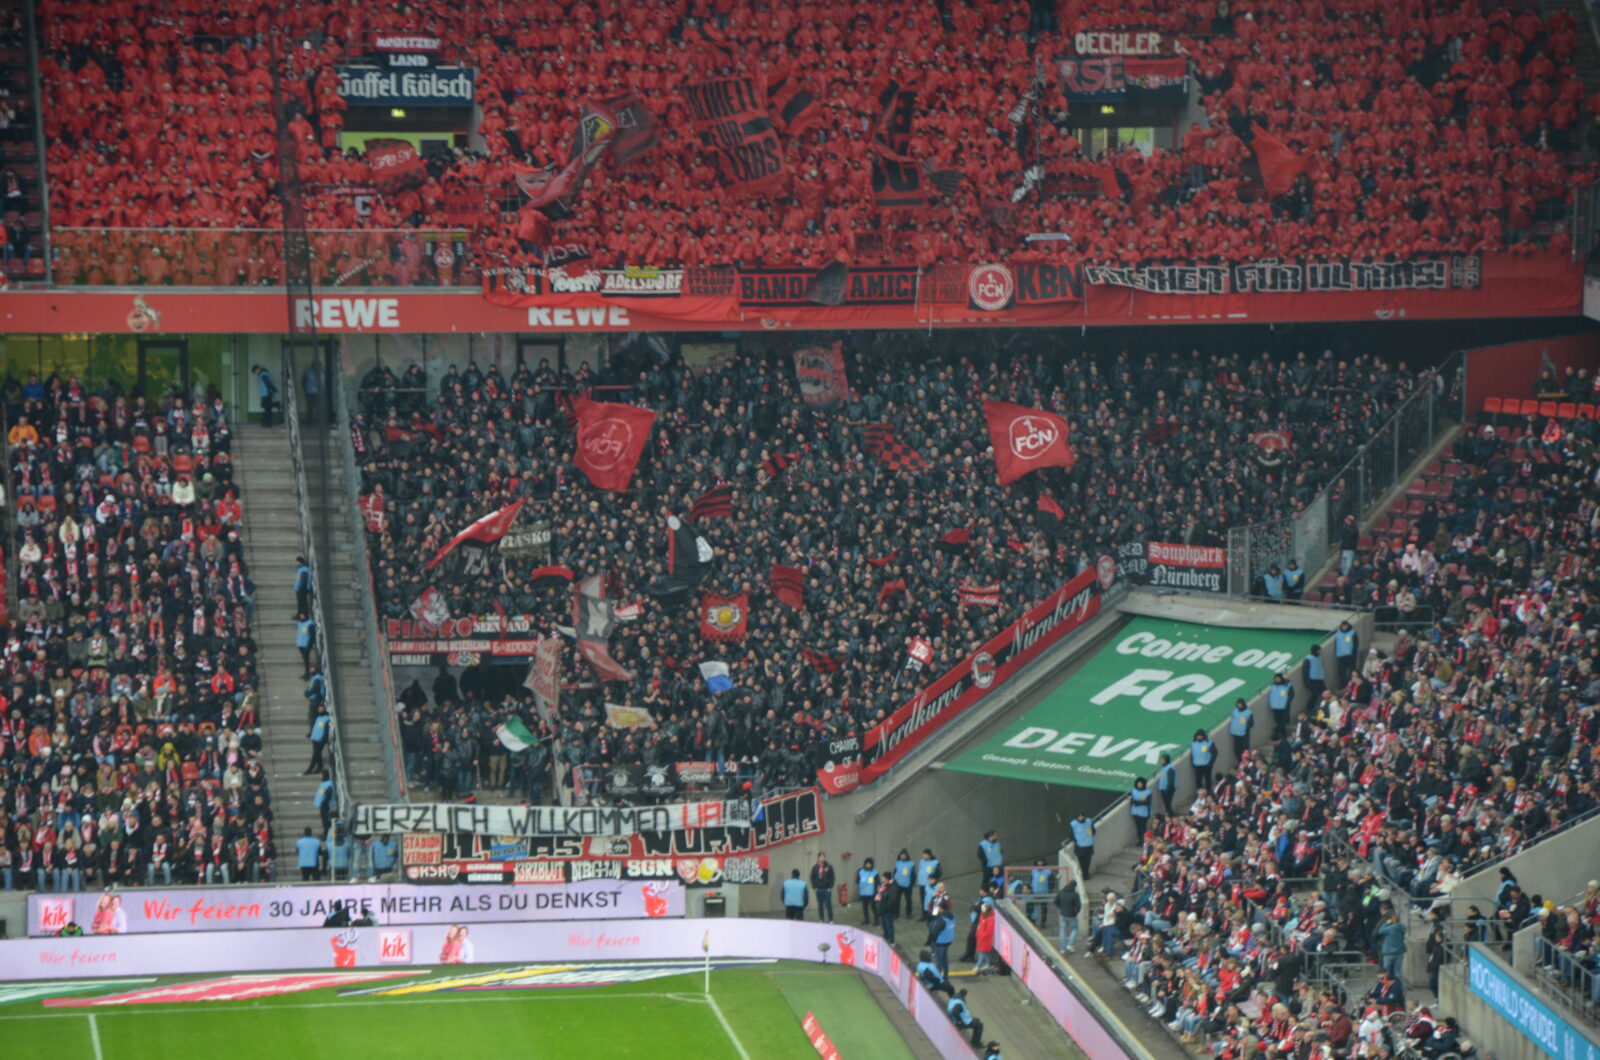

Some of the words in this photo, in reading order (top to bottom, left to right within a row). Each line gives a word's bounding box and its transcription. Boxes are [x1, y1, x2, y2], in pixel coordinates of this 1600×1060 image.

[1075, 32, 1161, 54] OECHLER
[389, 54, 428, 66] LAND
[402, 72, 472, 99] Kölsch
[605, 272, 682, 290] ADELSDORF
[1018, 263, 1082, 300] KBN
[1234, 258, 1301, 292] FÜR
[1306, 260, 1446, 291] ULTRAS!
[977, 283, 1004, 298] FCN
[295, 298, 400, 329] REWE
[1014, 429, 1053, 454] FCN
[1150, 564, 1221, 592] Nürnberg
[473, 621, 530, 633] SEENAND
[1116, 631, 1234, 664] Come
[870, 682, 964, 765] Nordkurve
[1007, 585, 1095, 664] Nürnberg
[1090, 668, 1246, 715] FC!
[1003, 726, 1180, 765] DEVK
[355, 806, 488, 833] HERZLICH
[508, 807, 670, 835] WILLKOMMEN
[403, 836, 441, 849] STADION
[404, 850, 441, 864] VERBOT
[627, 860, 674, 877] SGN
[43, 903, 69, 926] kik
[144, 898, 182, 920] Wir
[187, 898, 261, 924] feiern
[270, 901, 293, 918] 30
[380, 896, 443, 914] MEHR
[449, 895, 493, 912] ALS
[499, 893, 528, 911] DU
[535, 890, 623, 909] DENKST
[381, 934, 407, 957] kik
[1518, 996, 1559, 1053] SPRUDEL
